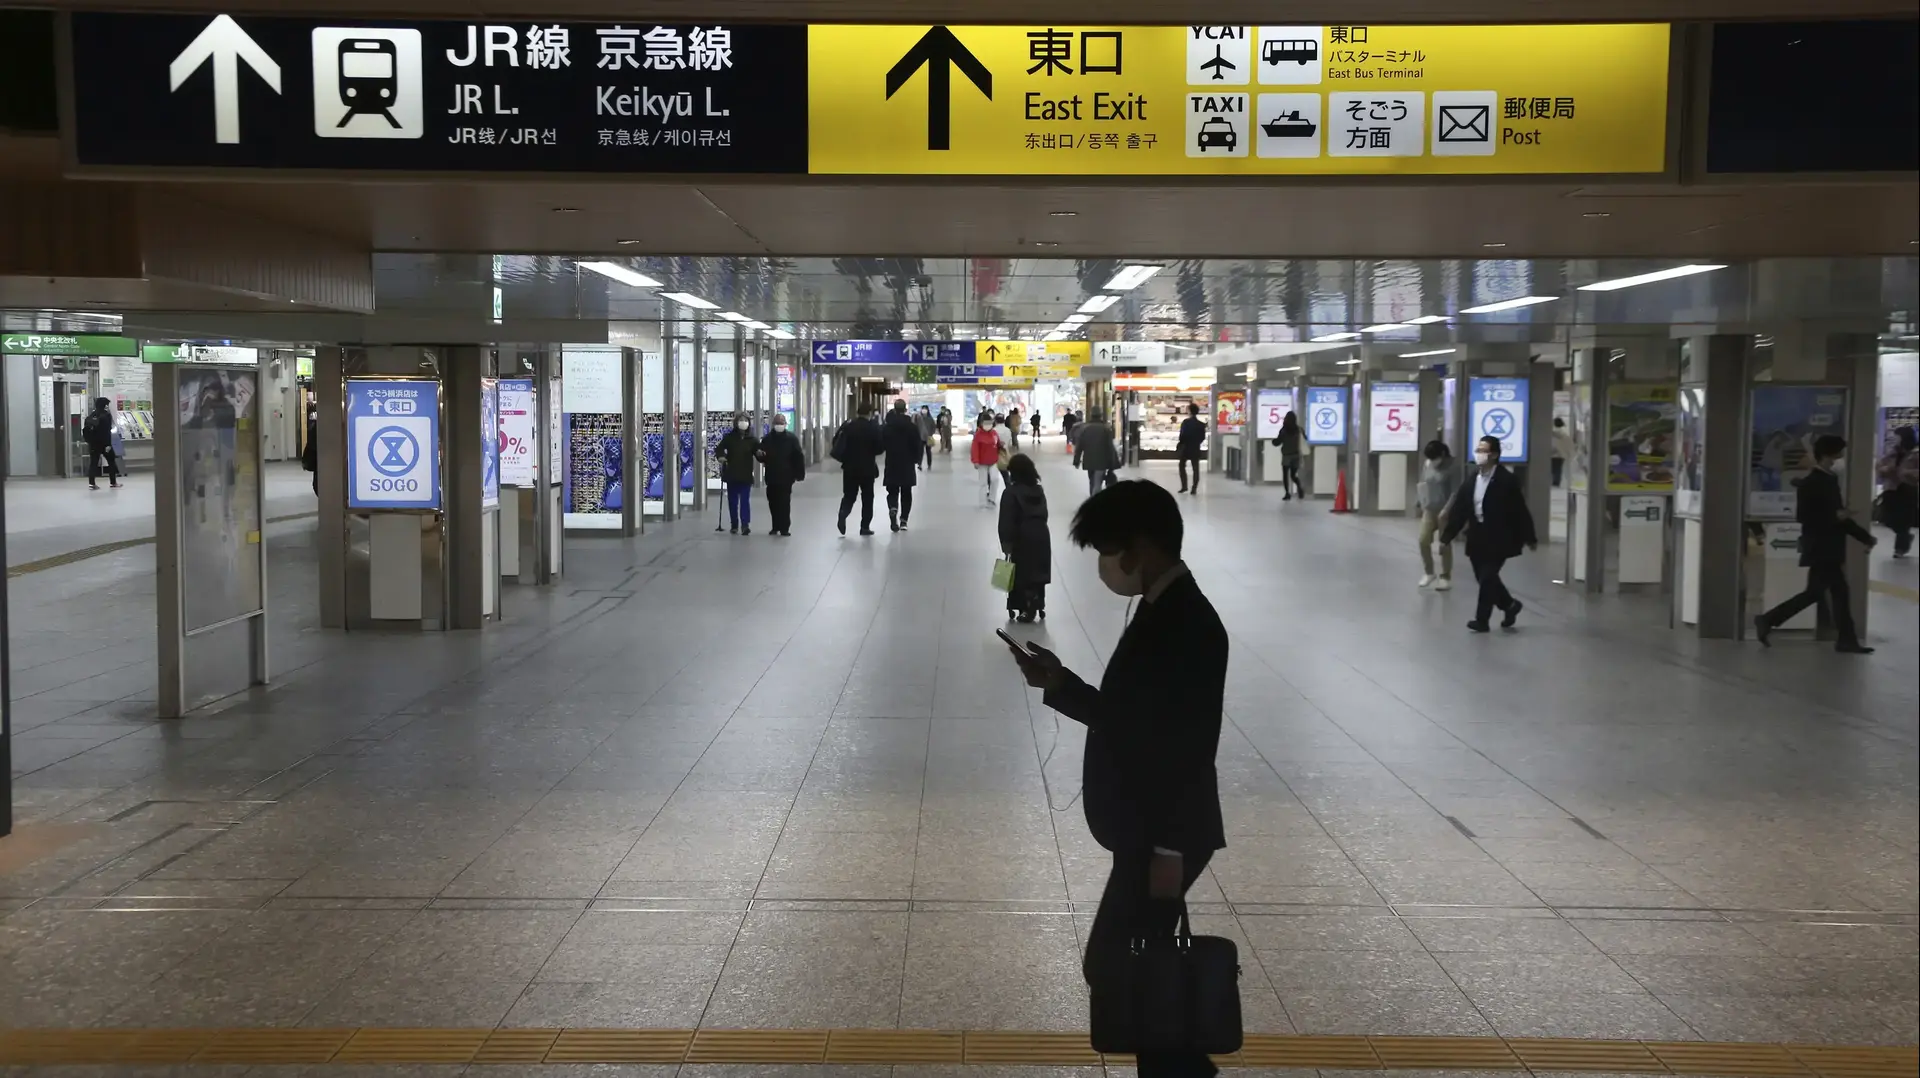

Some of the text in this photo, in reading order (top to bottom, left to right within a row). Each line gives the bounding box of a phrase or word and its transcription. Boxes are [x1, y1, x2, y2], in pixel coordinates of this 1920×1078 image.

[1330, 26, 1367, 44] 東口
[446, 25, 572, 69] JR線
[596, 25, 733, 70] 京急線
[1026, 28, 1122, 76] 東口
[1329, 50, 1426, 63] バスターミナル
[1328, 67, 1424, 78] East Bus Terminal
[448, 84, 519, 114] JR L.
[596, 86, 730, 124] Keikyū L.
[1025, 92, 1148, 120] East Exit
[1191, 97, 1243, 112] TAXI
[1504, 97, 1575, 119] 郵便局
[1346, 100, 1408, 121] そごう
[1126, 132, 1158, 149] 출구
[1346, 127, 1391, 149] 方面
[1503, 128, 1541, 145] Post
[20, 336, 41, 348] JR
[389, 401, 412, 412] 東口
[1269, 408, 1284, 424] 5
[370, 479, 418, 492] SOGO
